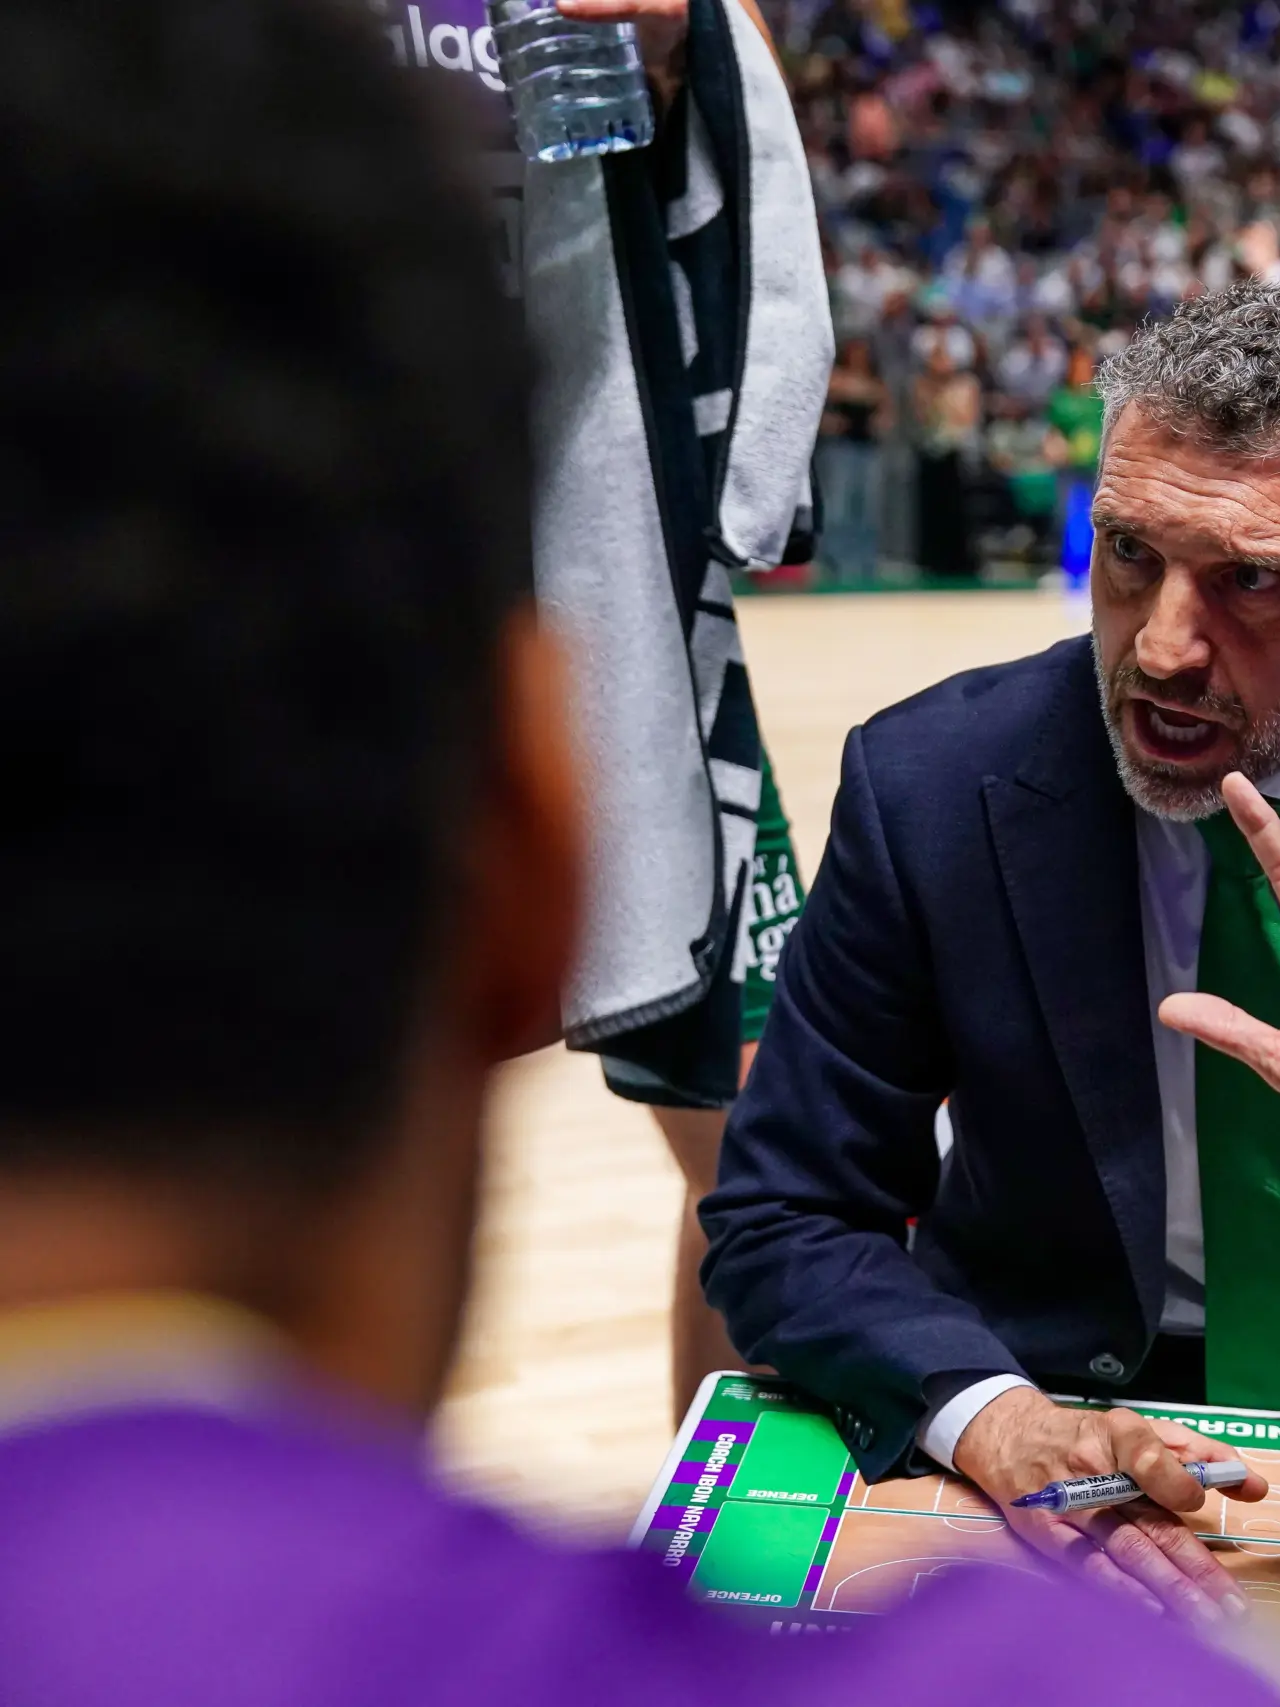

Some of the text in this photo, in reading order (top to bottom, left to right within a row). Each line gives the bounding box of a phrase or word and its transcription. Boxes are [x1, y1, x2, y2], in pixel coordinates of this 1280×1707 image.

[690, 1474, 718, 1503] IBON
[746, 1489, 818, 1501] DEFENCE
[1069, 1490, 1091, 1501] WHITE
[1091, 1486, 1115, 1498] BOARD
[663, 1506, 704, 1567] NAVARRO
[706, 1590, 782, 1603] OFFENCE
